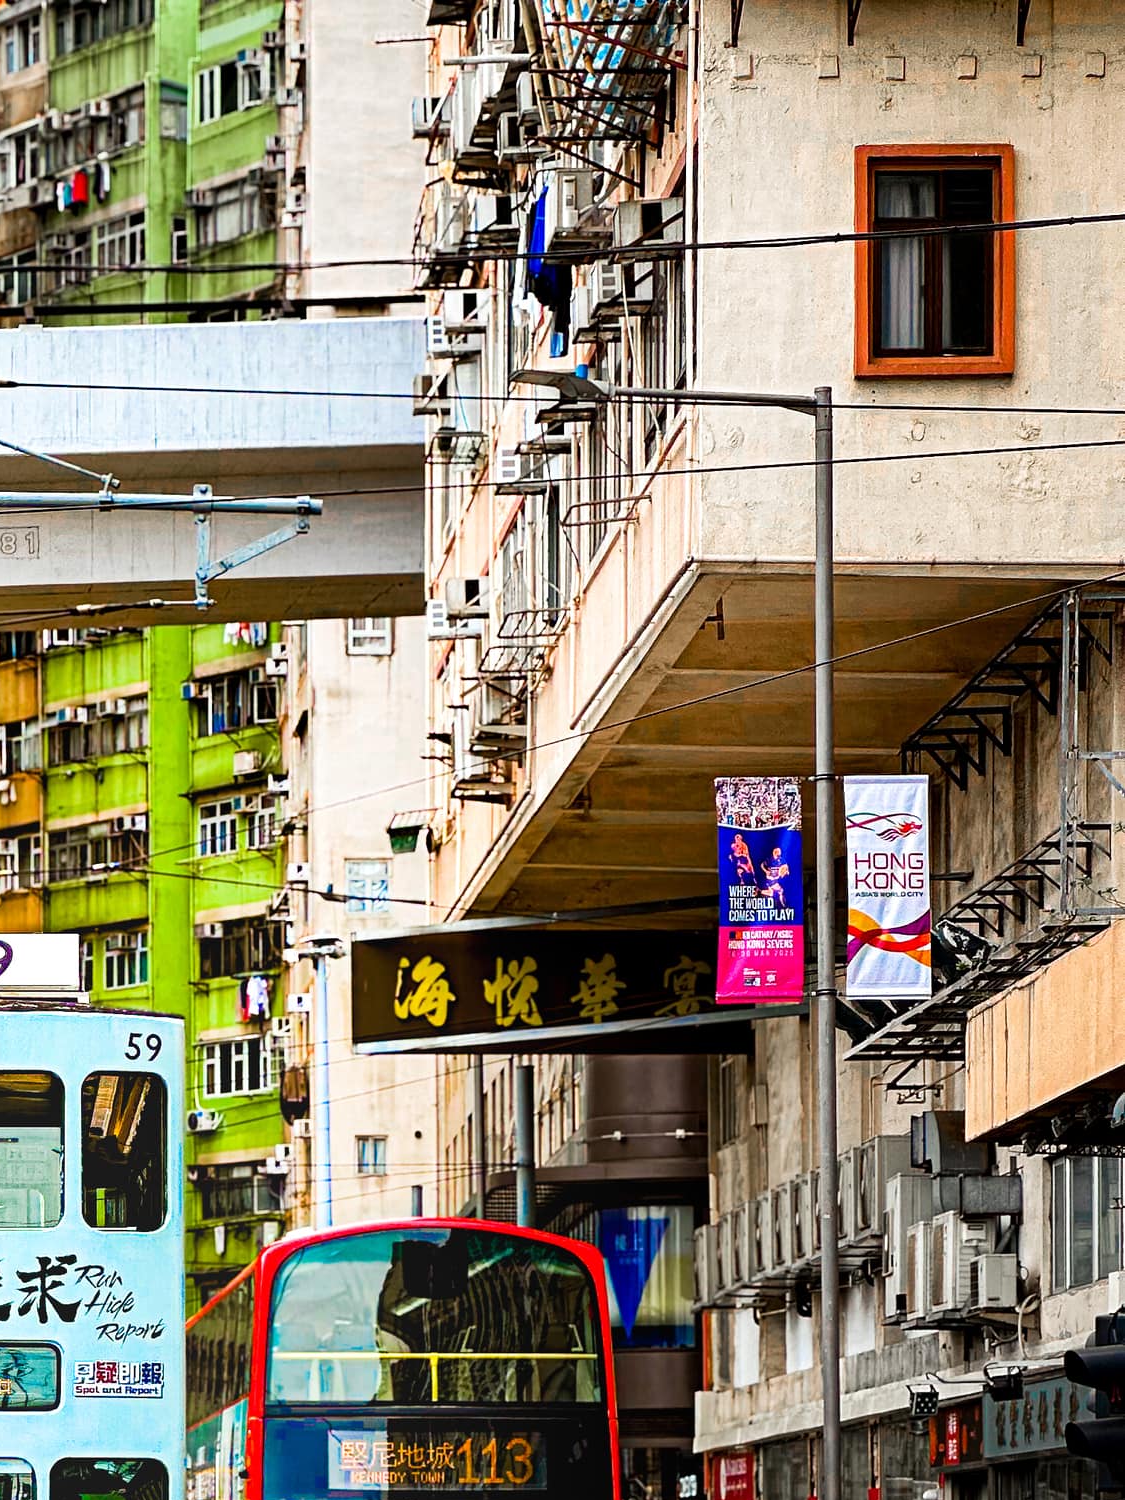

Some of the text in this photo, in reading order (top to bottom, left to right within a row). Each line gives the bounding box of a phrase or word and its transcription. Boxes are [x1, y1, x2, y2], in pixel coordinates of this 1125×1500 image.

[854, 852, 923, 870] HONG
[854, 872, 923, 890] KONG
[728, 885, 756, 897] WHERE
[728, 898, 774, 909] THE WORLD
[728, 909, 794, 922] COMES TO PLAY!
[728, 939, 793, 950] HONG KONG SEVENS
[124, 1033, 162, 1062] 59
[75, 1264, 124, 1289] Run
[83, 1290, 136, 1320] Hide
[96, 1318, 166, 1347] Report
[125, 1386, 159, 1395] Report
[339, 1440, 455, 1470] 堅尼地城
[457, 1436, 534, 1484] 113
[351, 1471, 445, 1484] KENNEDY TOWN
